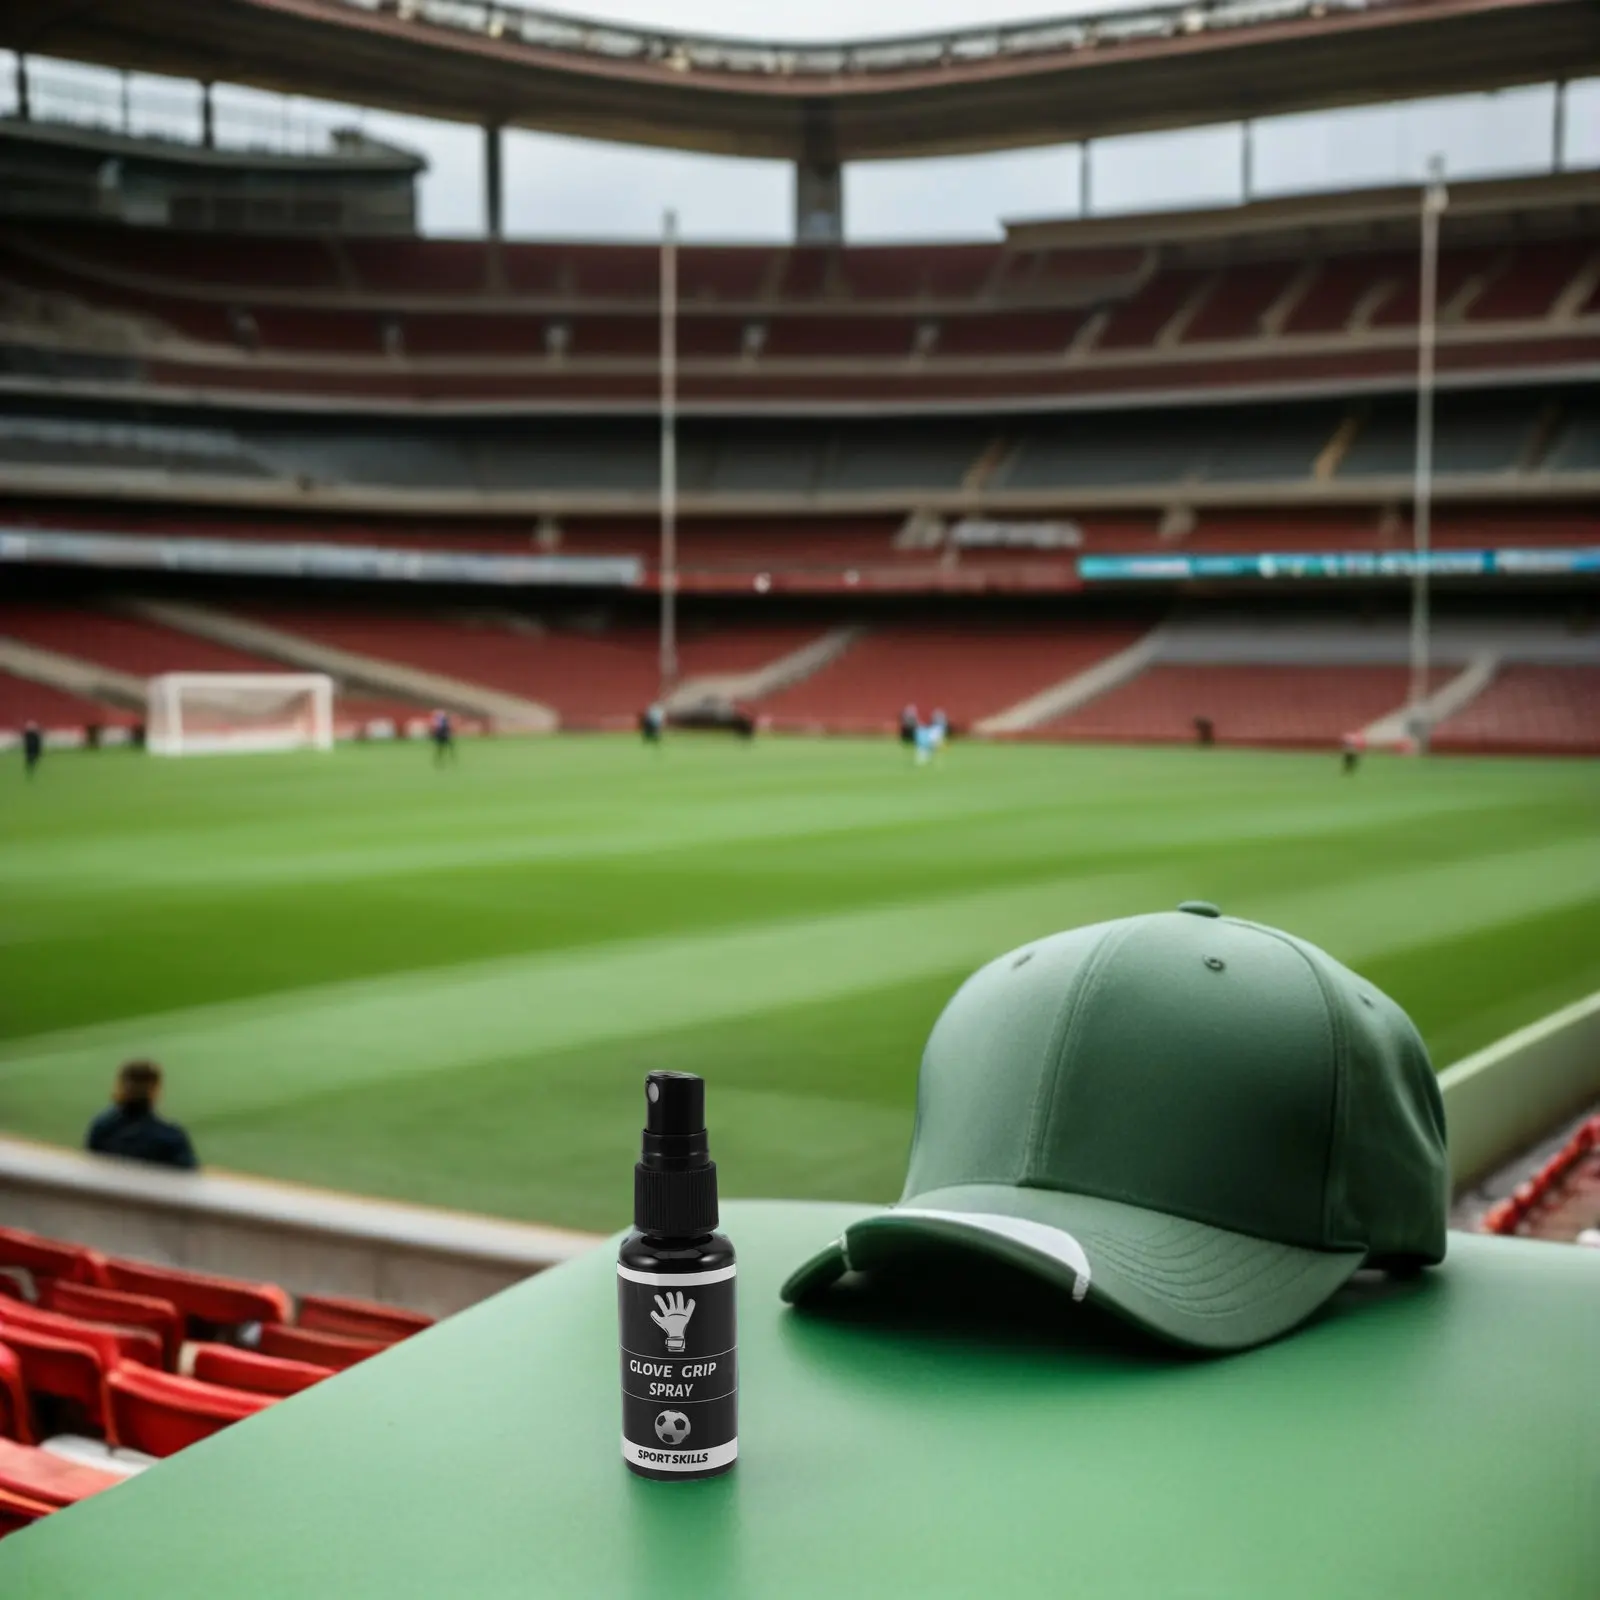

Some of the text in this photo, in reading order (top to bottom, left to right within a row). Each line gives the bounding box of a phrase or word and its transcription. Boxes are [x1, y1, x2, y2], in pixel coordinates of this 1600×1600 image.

[629, 1359, 717, 1378] GLOVE GRIP
[649, 1382, 694, 1397] SPRAY
